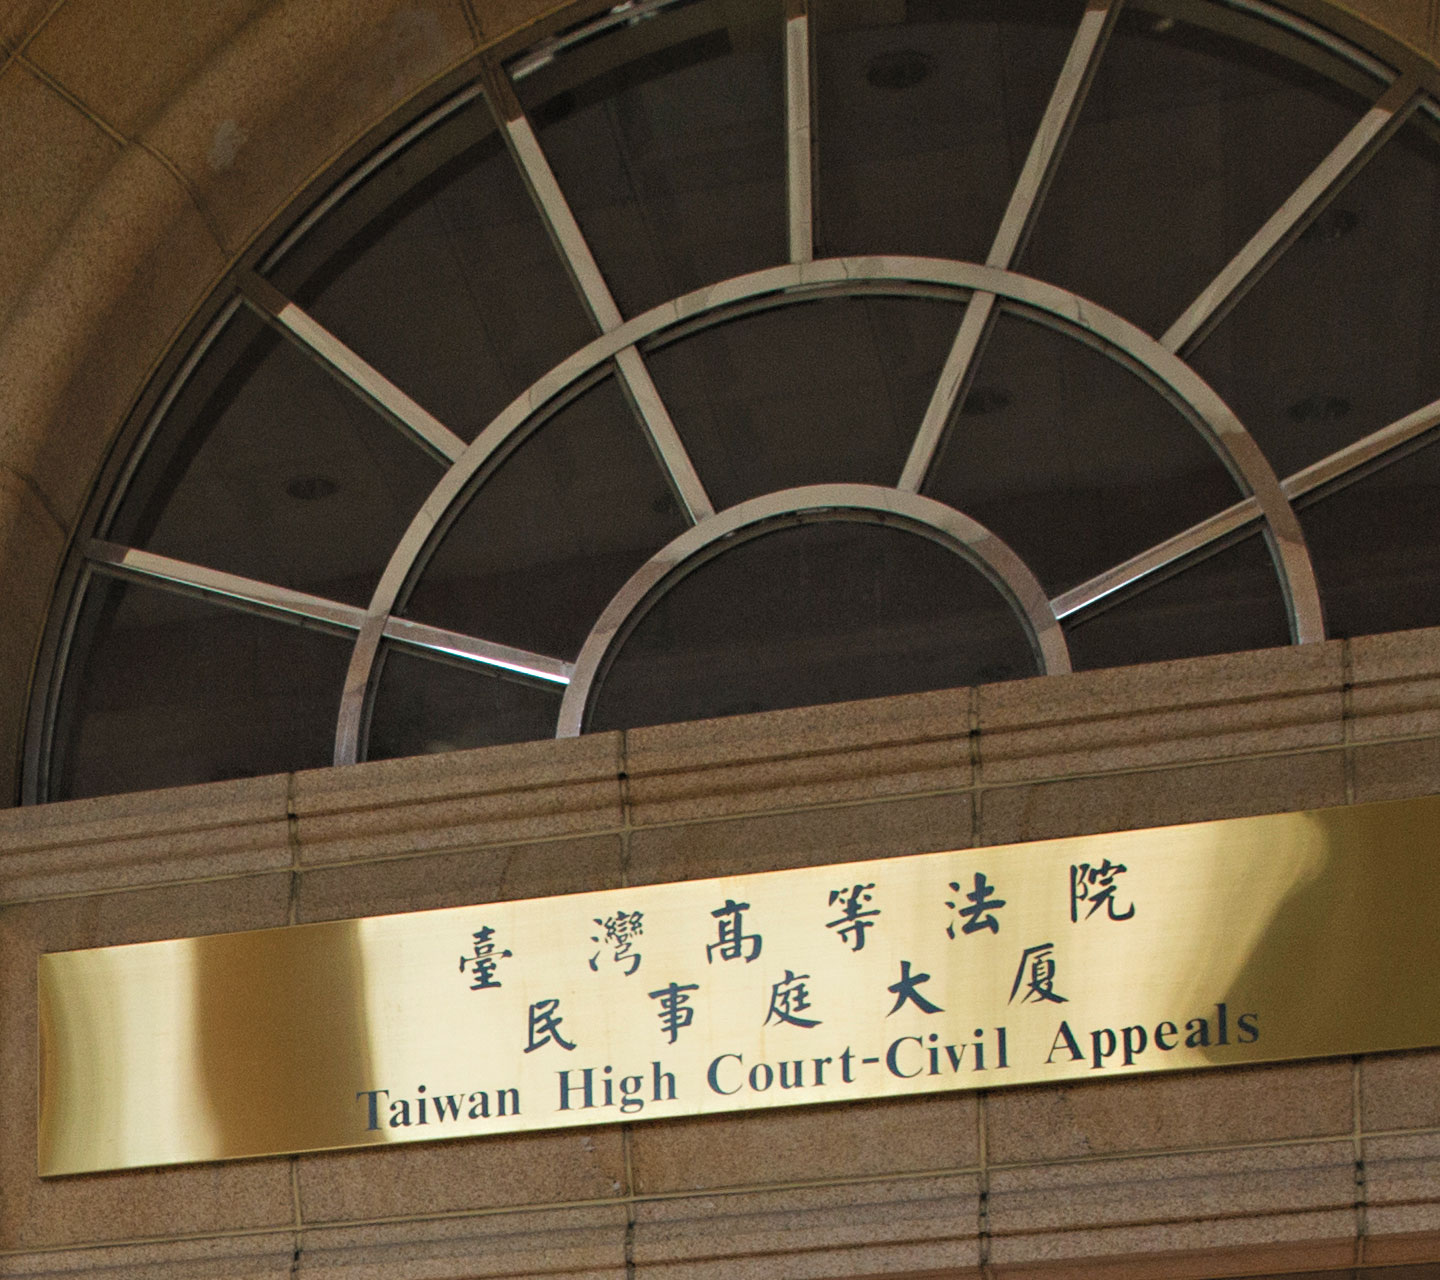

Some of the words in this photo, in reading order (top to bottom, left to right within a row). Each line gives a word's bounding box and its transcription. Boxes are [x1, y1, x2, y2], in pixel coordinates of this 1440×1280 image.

[458, 860, 1138, 992] 臺灣高等法院
[356, 1086, 523, 1133] Taiwan
[557, 1066, 677, 1116] High
[707, 1026, 1010, 1095] Court-Civil
[1044, 1003, 1261, 1069] Appeals
